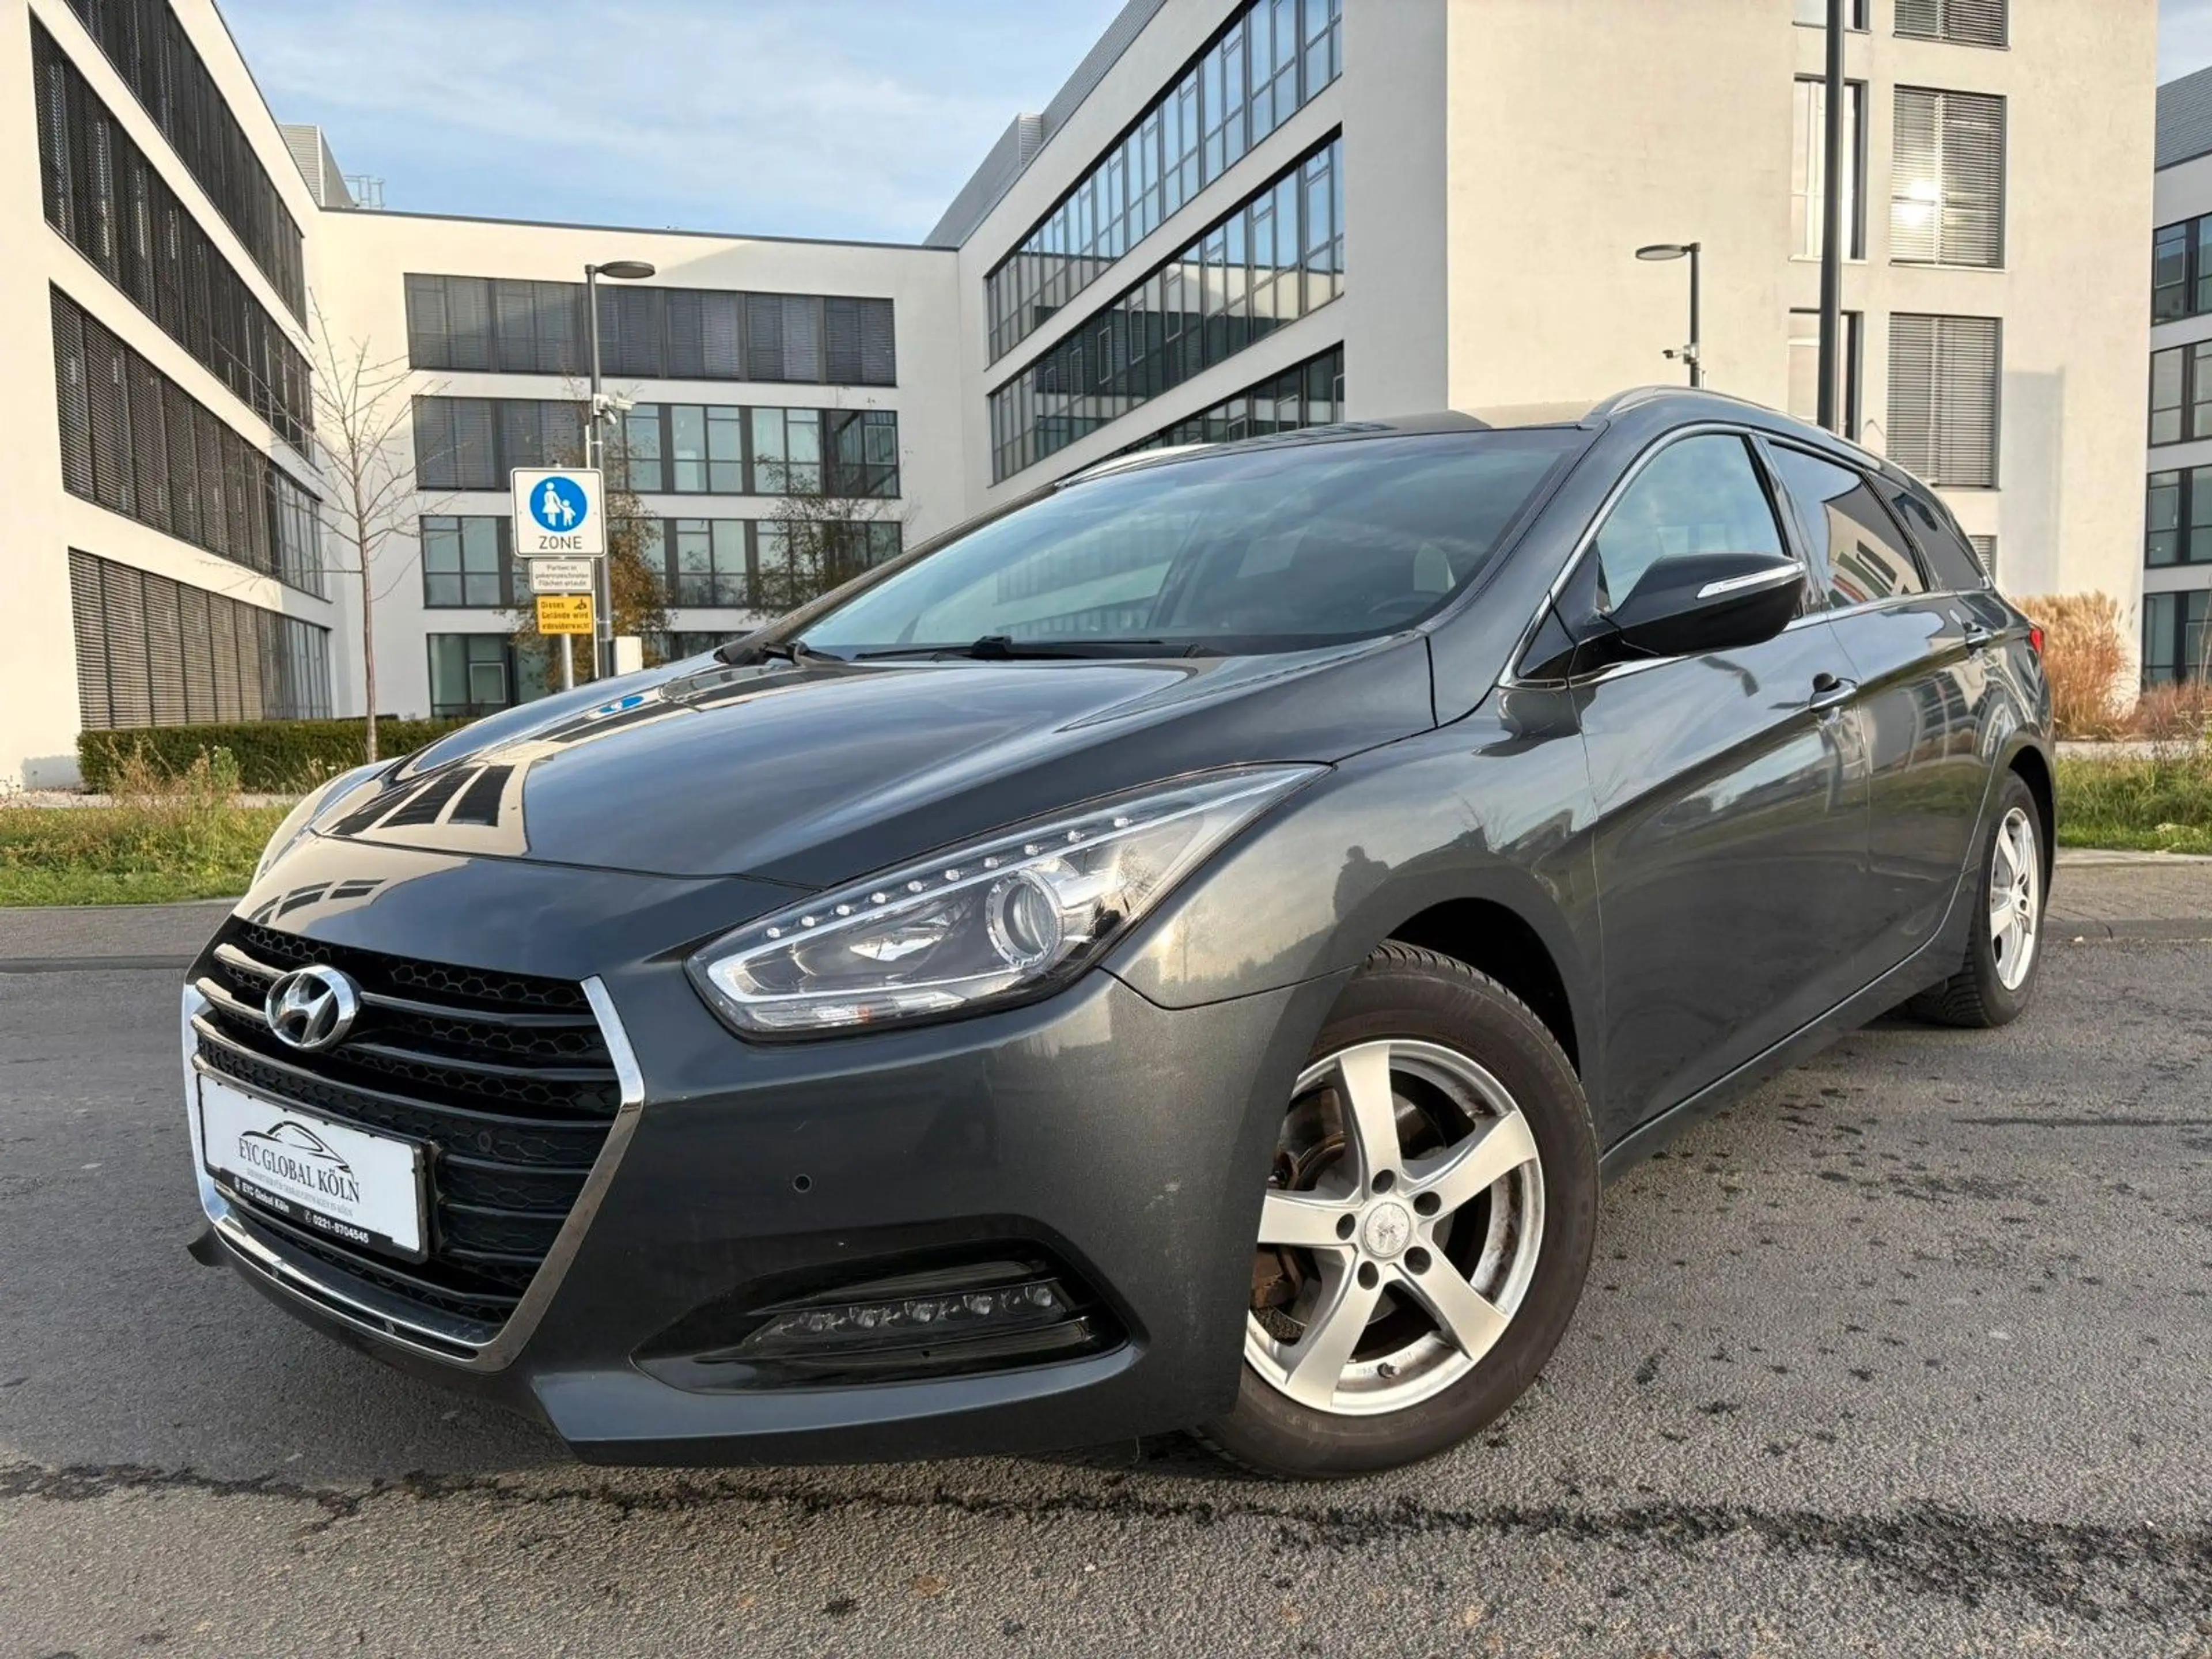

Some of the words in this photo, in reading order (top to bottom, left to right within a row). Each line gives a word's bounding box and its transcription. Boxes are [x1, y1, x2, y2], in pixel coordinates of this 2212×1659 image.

[539, 536, 583, 550] ZONE
[573, 611, 588, 619] wird
[239, 1137, 261, 1166] EYC
[262, 1148, 315, 1188] GLOBAL
[317, 1168, 360, 1204] KÖLN
